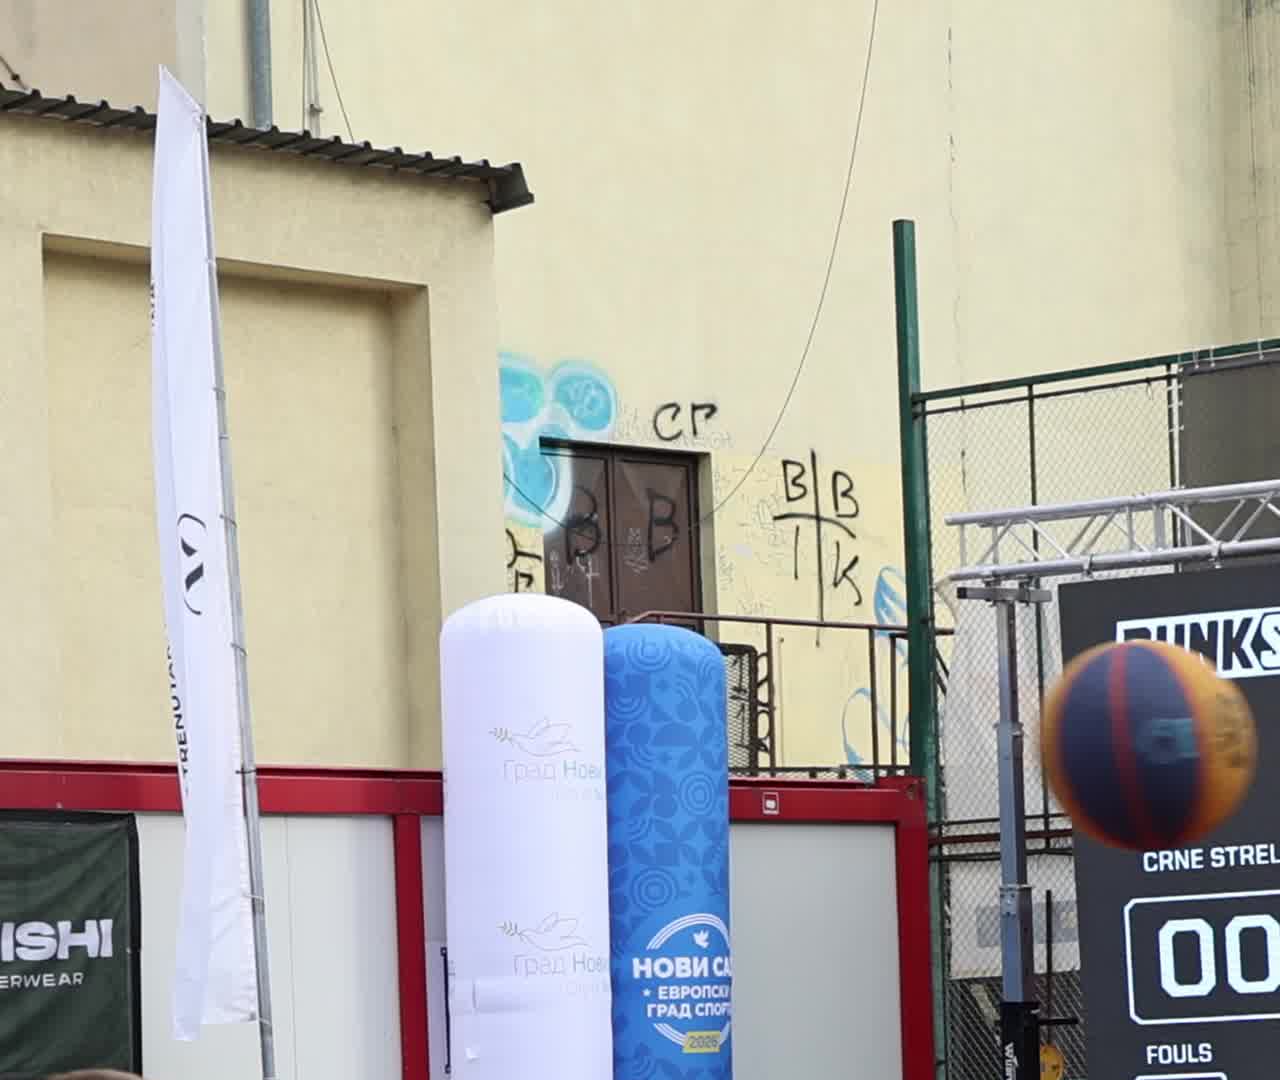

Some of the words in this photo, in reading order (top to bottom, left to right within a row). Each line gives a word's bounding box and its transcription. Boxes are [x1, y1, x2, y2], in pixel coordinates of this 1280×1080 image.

[1143, 848, 1205, 872] CRNE
[632, 957, 709, 980] НОВИ
[647, 1003, 692, 1019] ГРАД
[1146, 1042, 1213, 1064] FOULS
